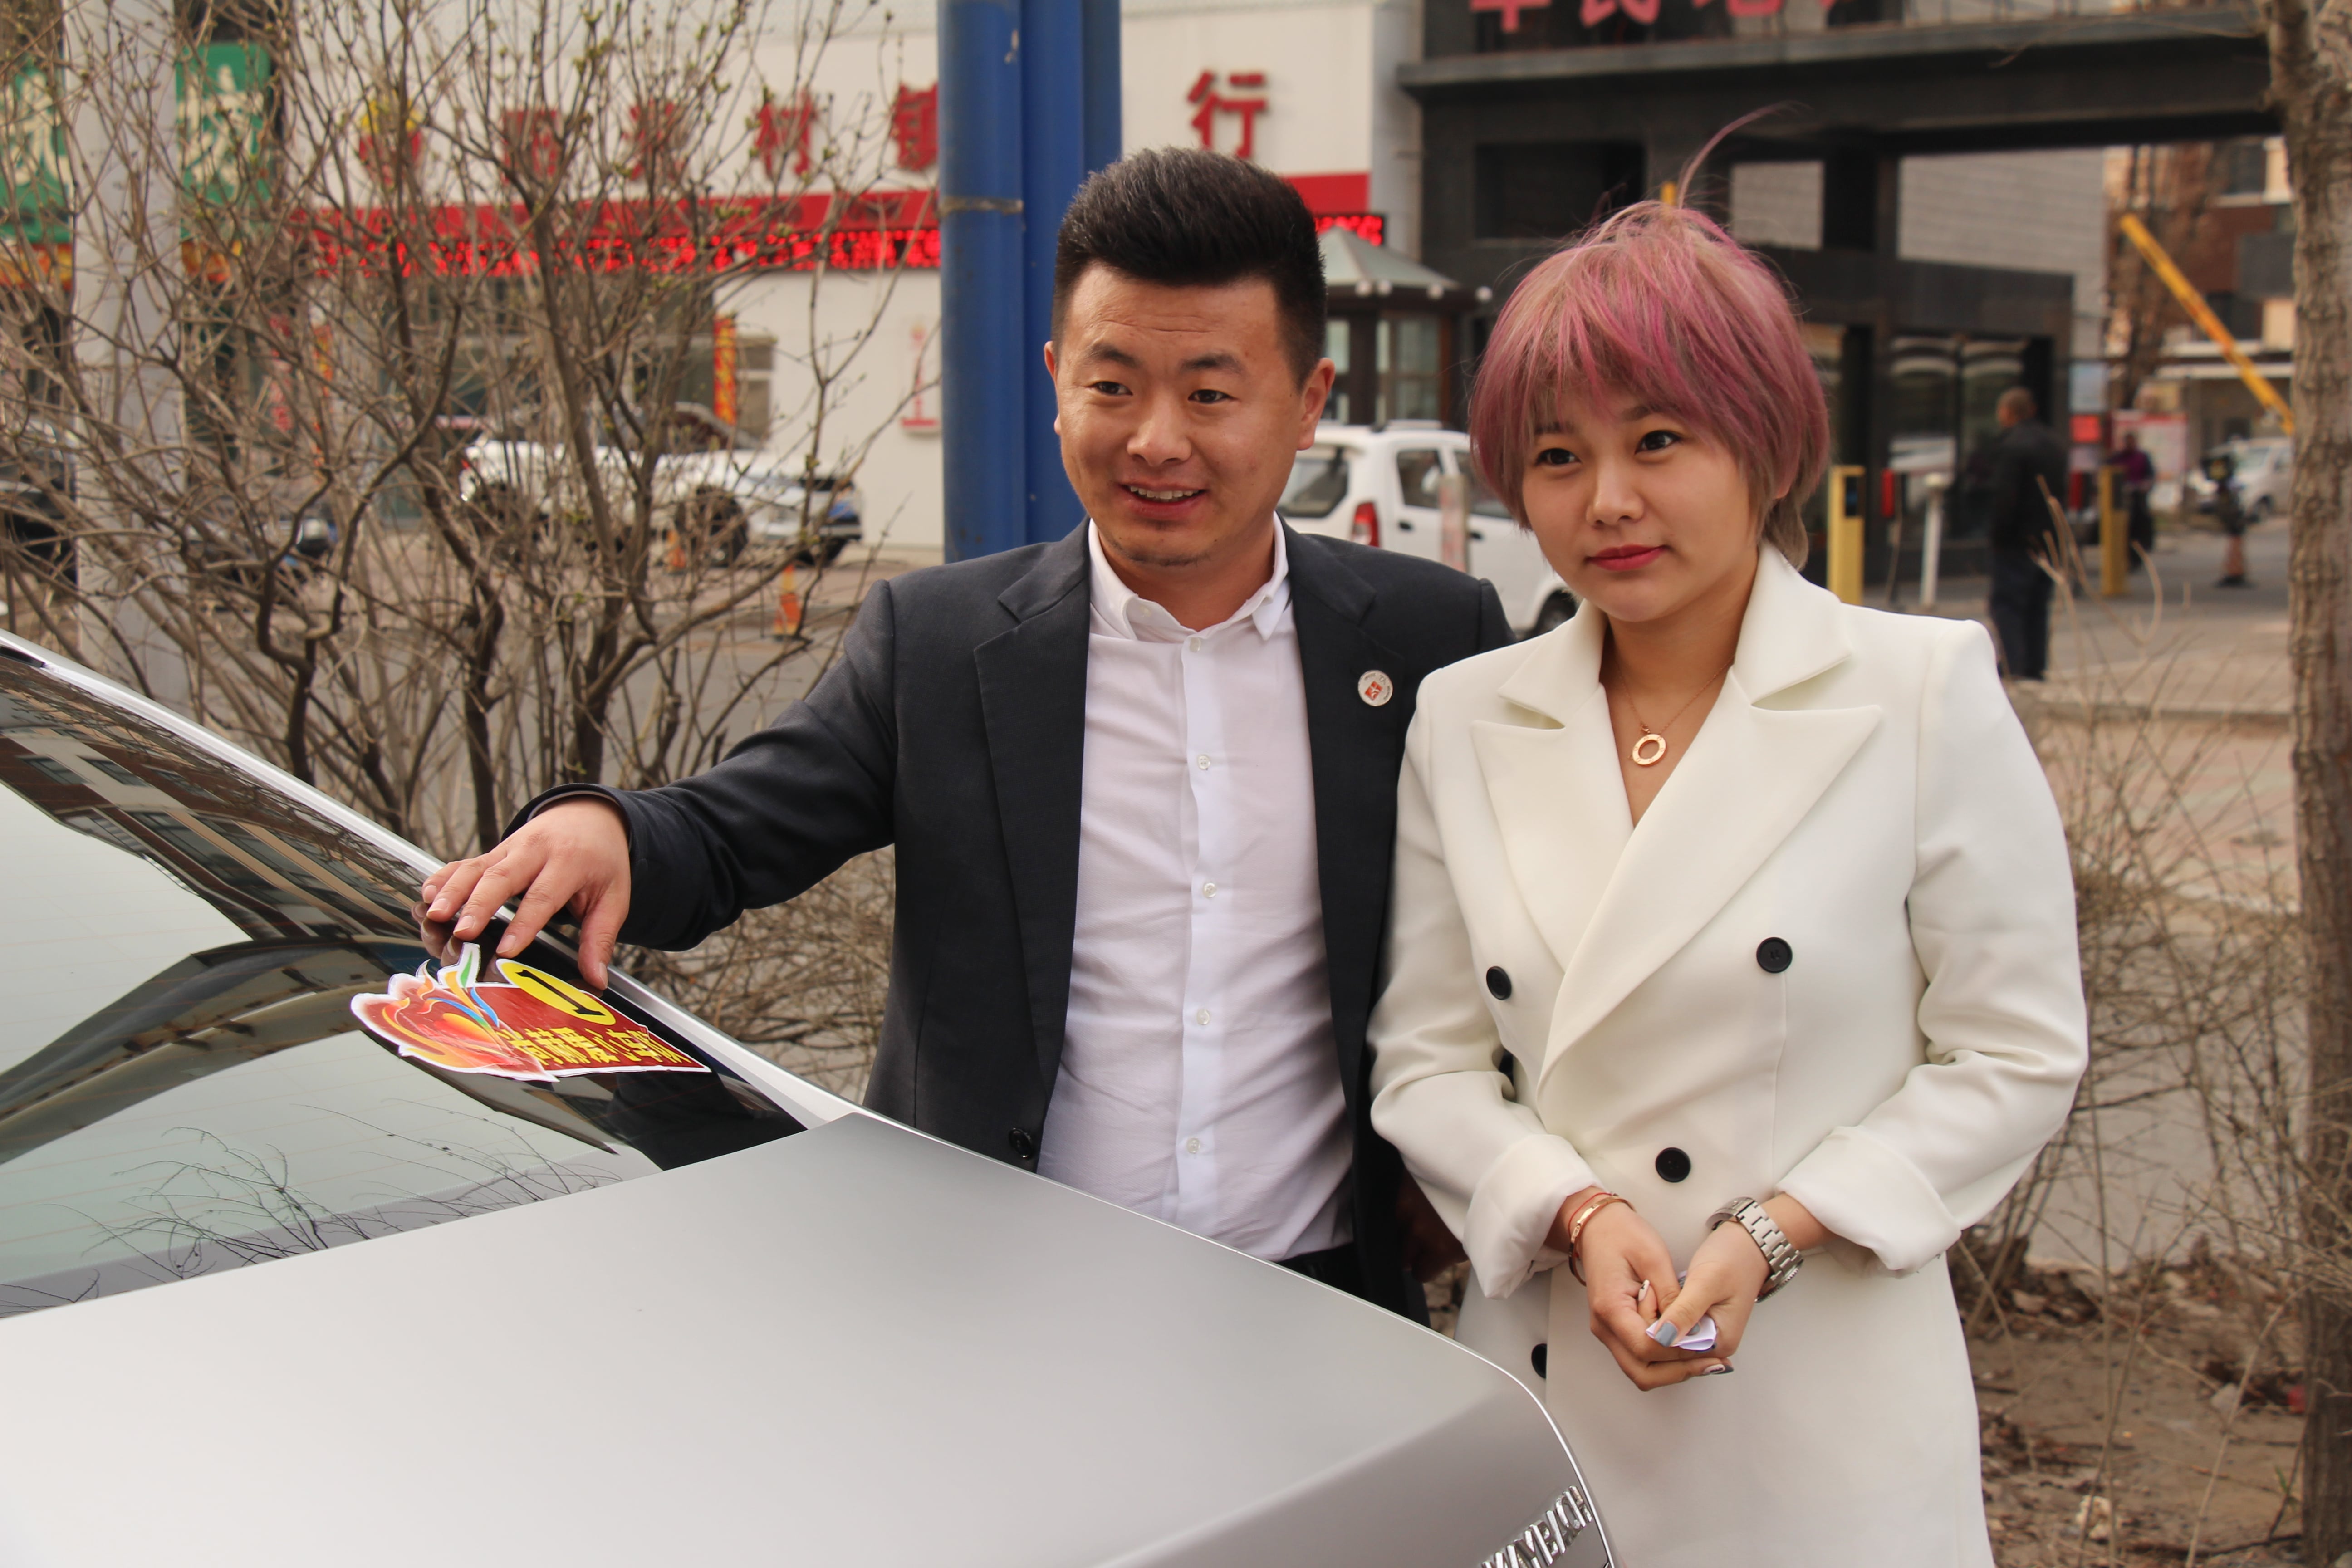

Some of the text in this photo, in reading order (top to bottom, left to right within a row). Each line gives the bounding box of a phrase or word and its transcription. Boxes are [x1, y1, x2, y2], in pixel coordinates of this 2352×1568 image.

[1186, 69, 1269, 160] 行
[515, 969, 606, 1016] 1
[497, 1027, 692, 1066] 尚赫爱心车队
[1481, 1485, 1592, 1568] AYBACH
